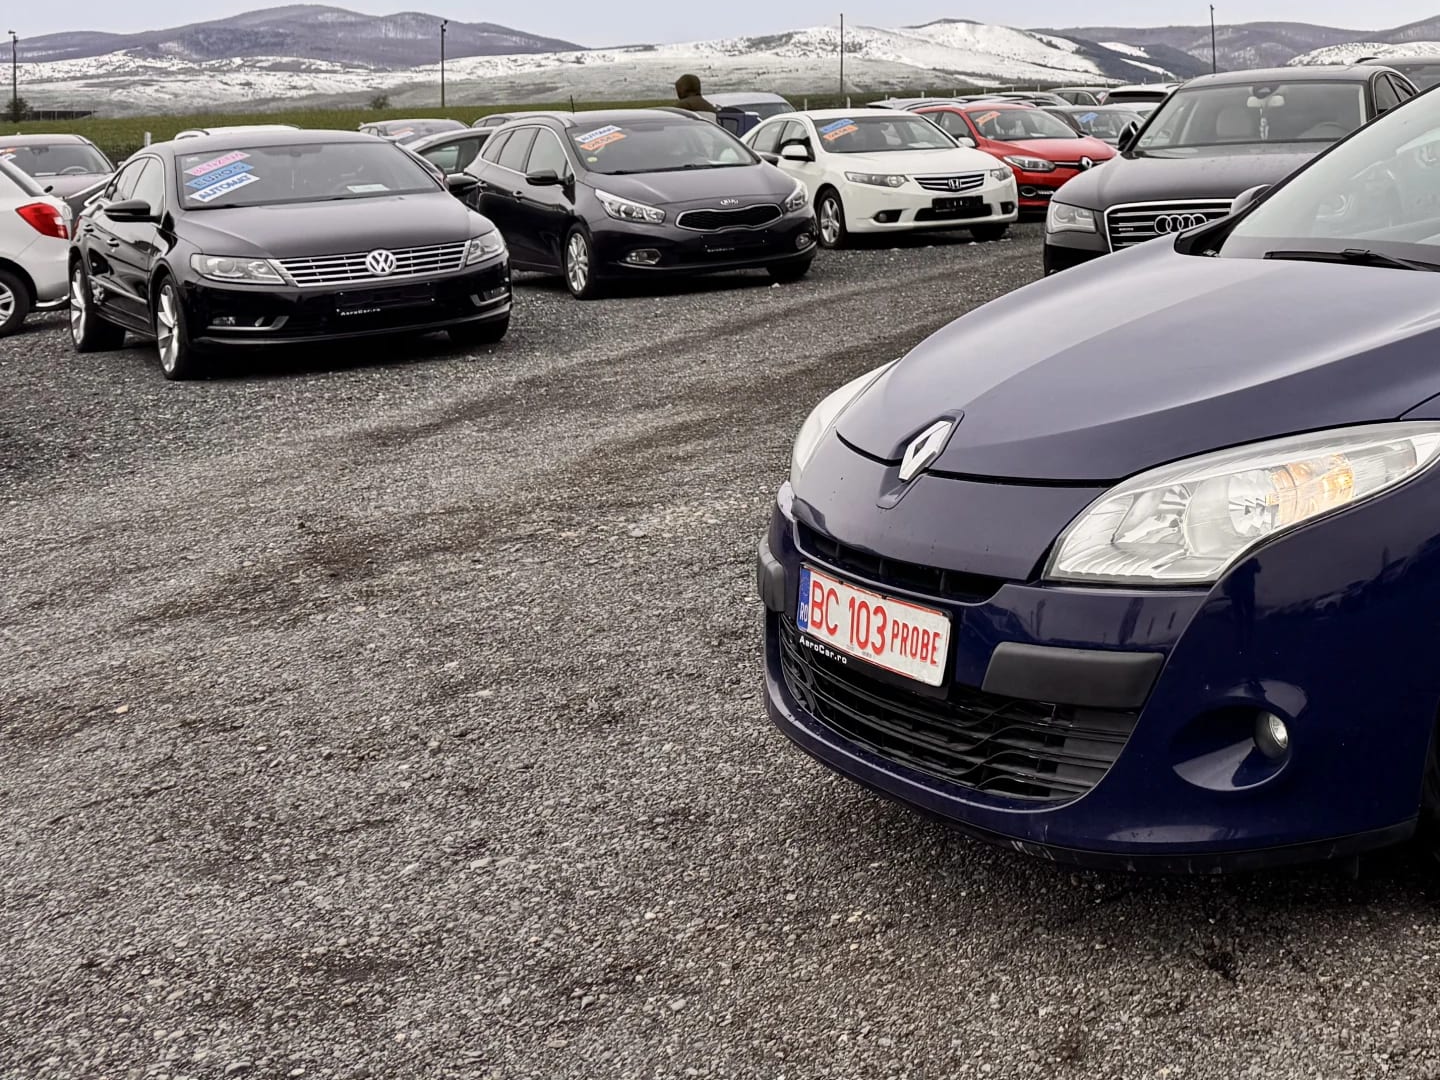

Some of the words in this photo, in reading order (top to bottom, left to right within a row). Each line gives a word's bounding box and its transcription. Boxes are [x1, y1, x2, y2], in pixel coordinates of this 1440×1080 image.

[198, 175, 251, 199] AUTOMAT
[365, 249, 397, 276] VW
[799, 602, 809, 623] RO
[810, 580, 839, 636] BC
[848, 596, 888, 656] 103
[890, 619, 941, 665] PROBE
[799, 635, 848, 665] AeroCar.ro
